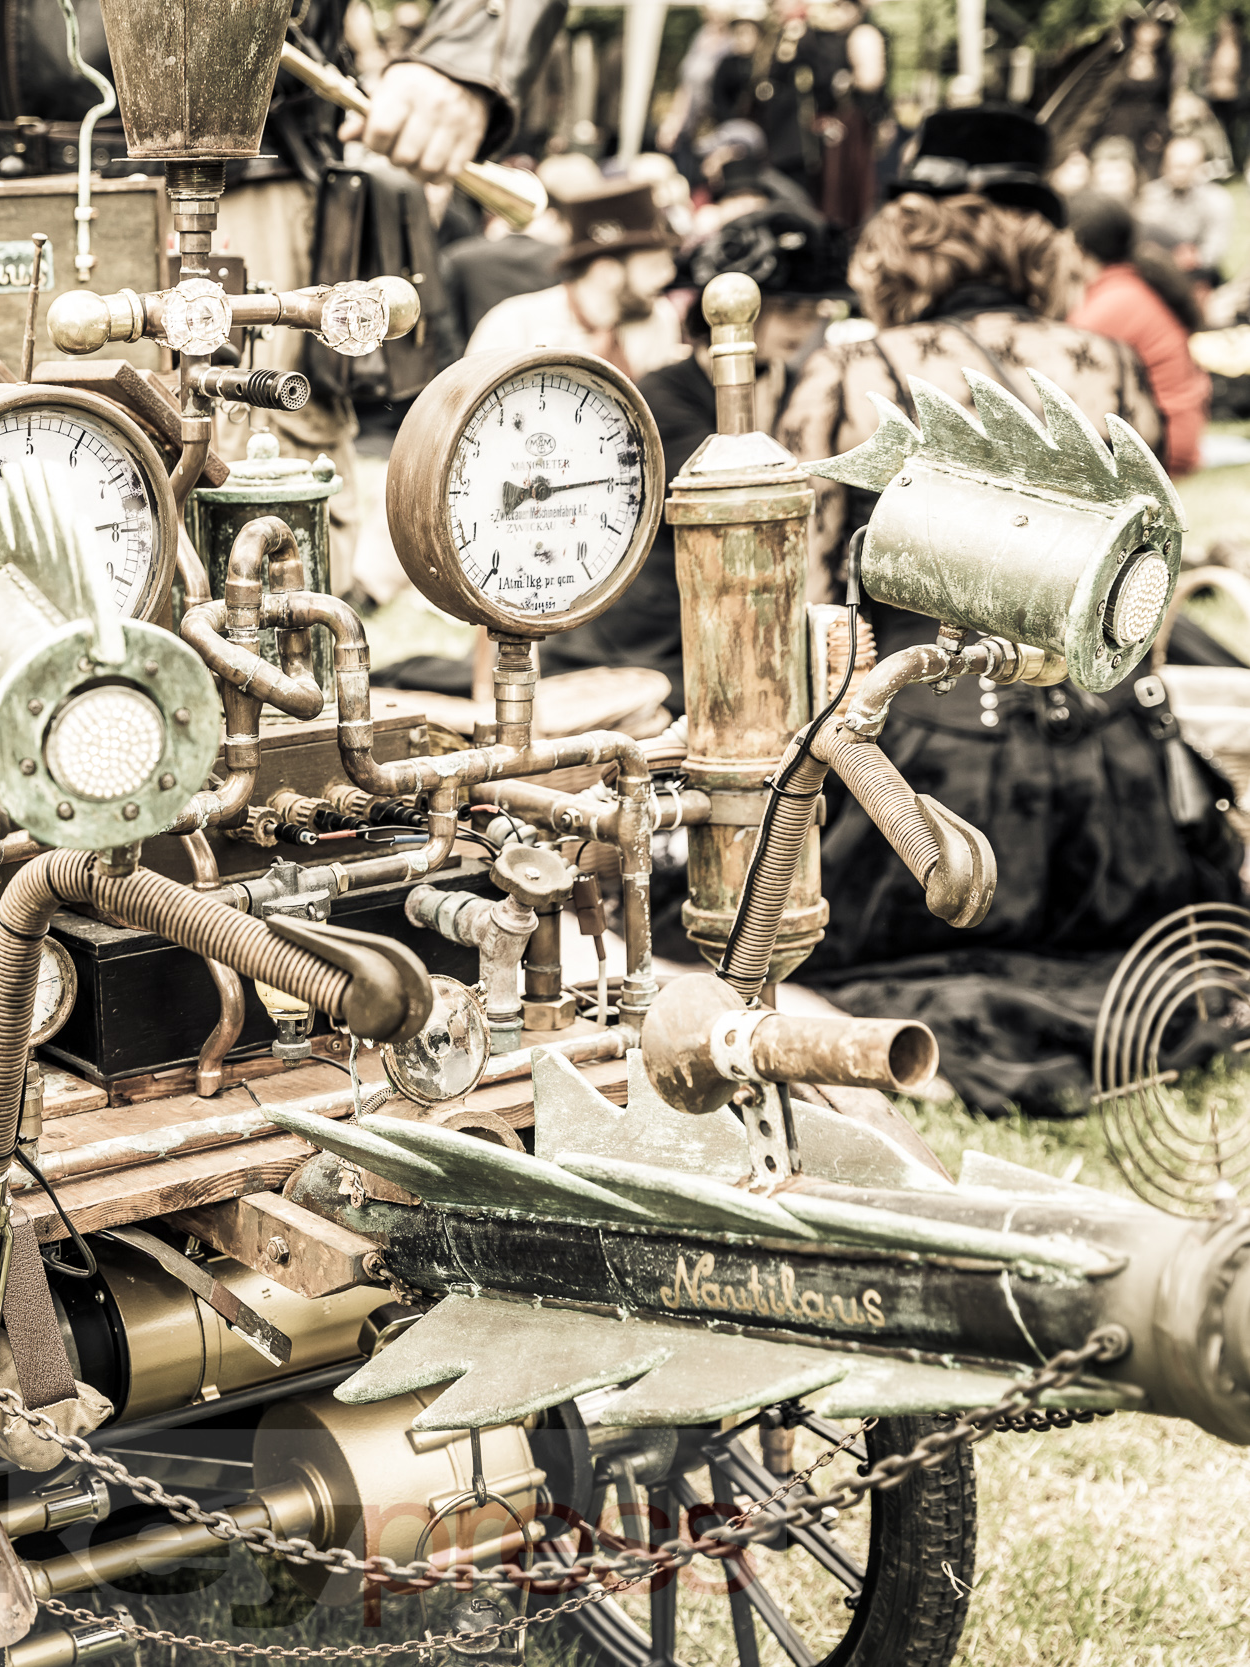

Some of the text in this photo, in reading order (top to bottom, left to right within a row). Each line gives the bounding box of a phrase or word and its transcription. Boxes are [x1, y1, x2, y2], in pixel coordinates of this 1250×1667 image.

[538, 394, 546, 412] 5
[574, 407, 582, 425] 6
[25, 437, 34, 456] 5
[472, 440, 480, 458] 3
[599, 436, 606, 454] 7
[69, 450, 78, 469] 6
[98, 480, 107, 500] 7
[600, 513, 608, 531] 9
[111, 521, 120, 543] 8
[472, 522, 478, 542] 1
[491, 549, 500, 570] 0
[576, 541, 588, 561] 10
[106, 561, 115, 583] 9
[660, 1252, 886, 1327] Nautilaus
